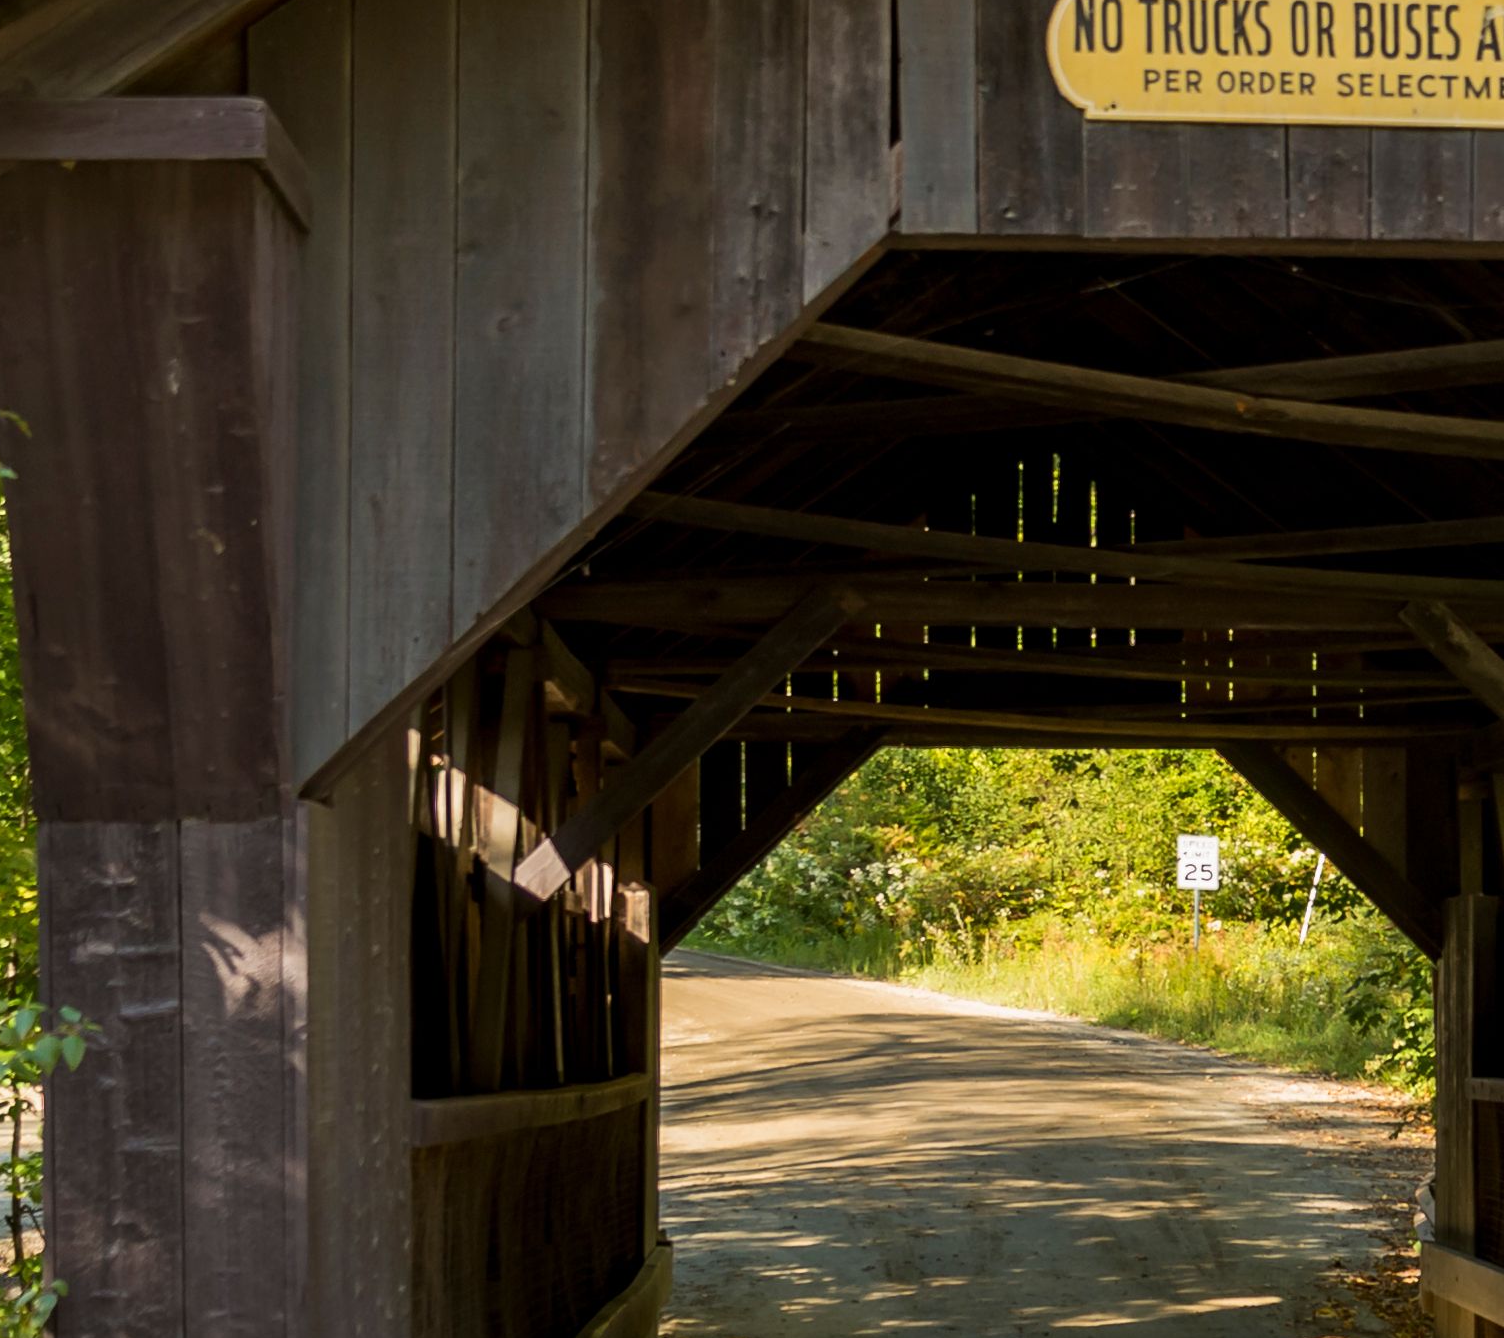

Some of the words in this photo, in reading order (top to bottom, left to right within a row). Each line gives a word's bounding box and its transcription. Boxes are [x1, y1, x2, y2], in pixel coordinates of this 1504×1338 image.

[1290, 0, 1336, 58] OR
[1353, 2, 1461, 61] BUSES
[1144, 69, 1202, 93] PER
[1217, 70, 1316, 95] ORDER
[1184, 863, 1214, 882] 25
